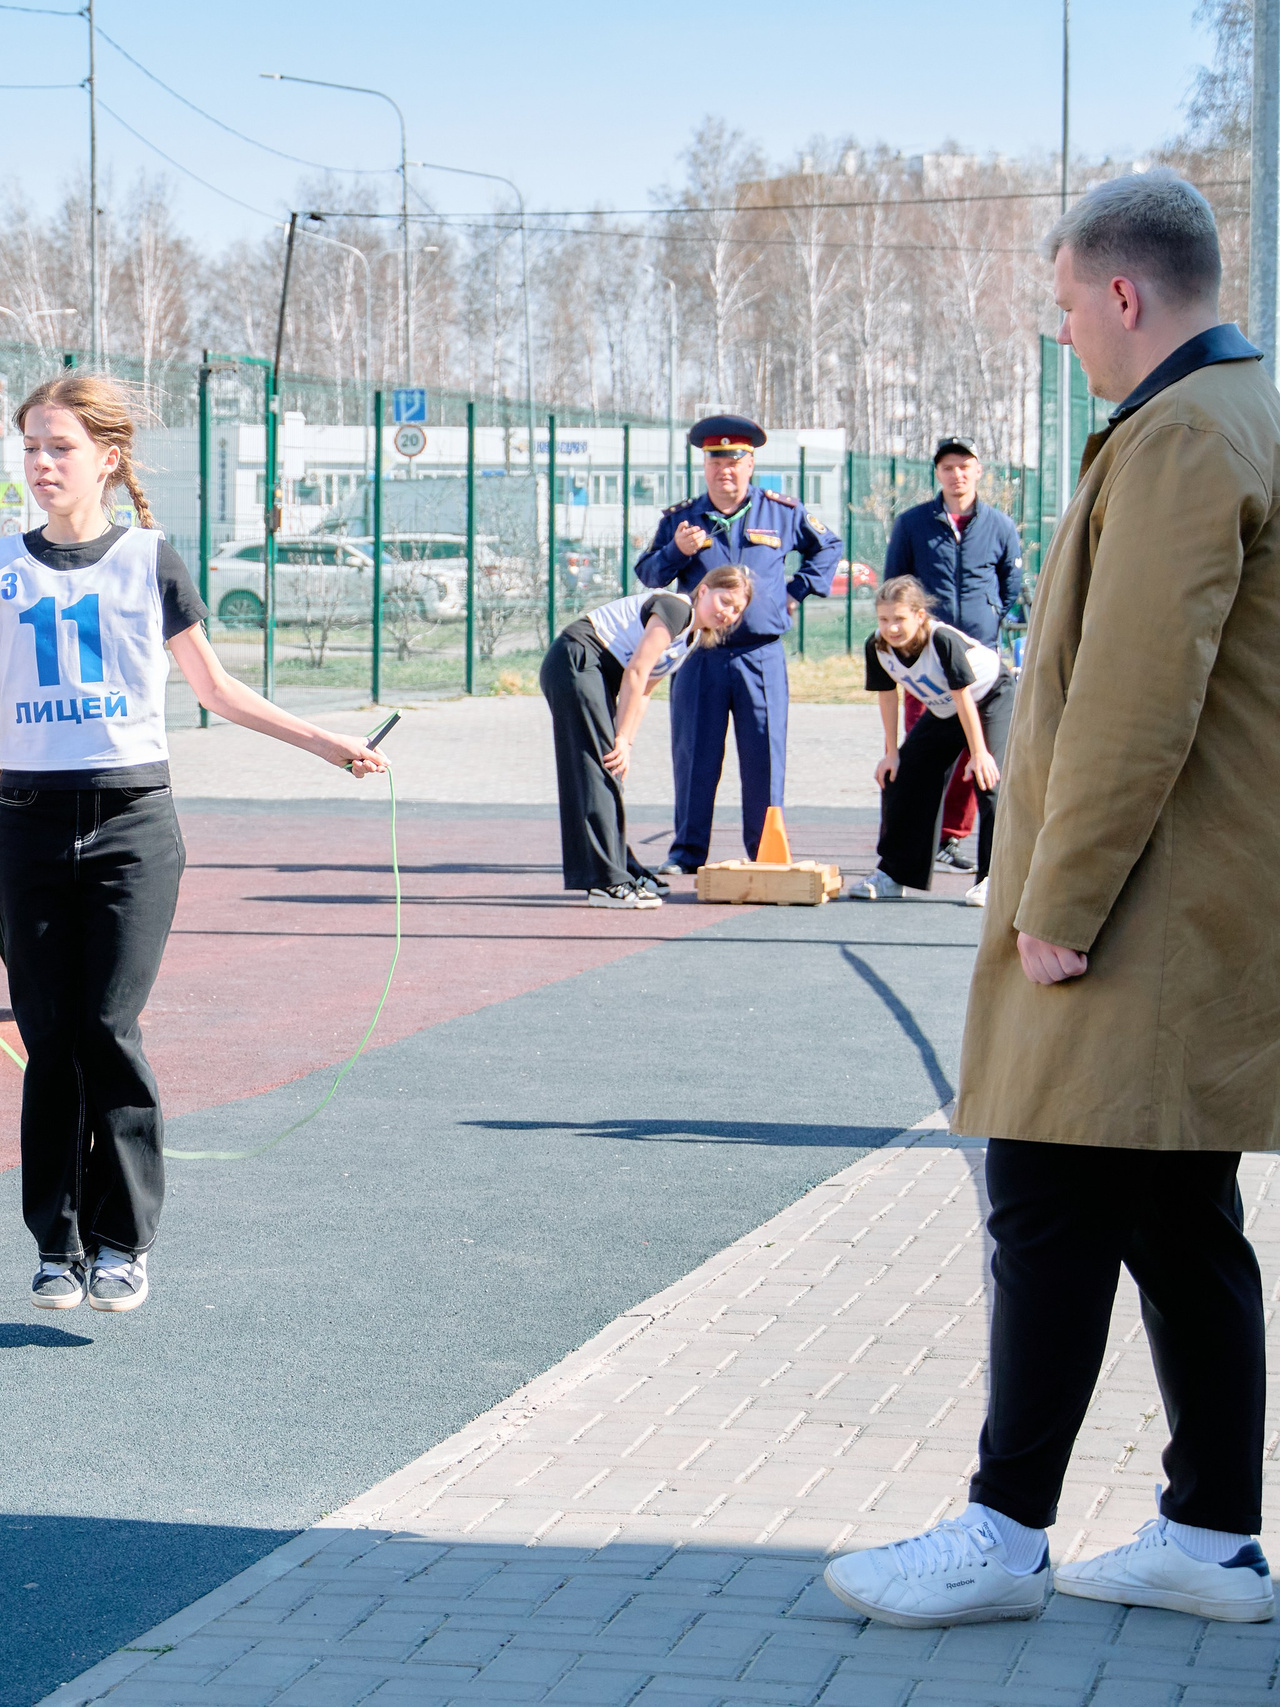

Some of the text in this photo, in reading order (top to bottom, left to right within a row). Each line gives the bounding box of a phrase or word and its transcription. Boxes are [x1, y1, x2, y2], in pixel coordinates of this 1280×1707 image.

[401, 433, 419, 447] 20
[0, 572, 18, 601] 3
[18, 593, 104, 687] 11
[888, 660, 896, 672] 2
[901, 673, 946, 697] 11
[15, 690, 128, 725] ЛИЦЕЙ
[982, 1521, 997, 1545] Reebok
[946, 1578, 975, 1590] Reebok
